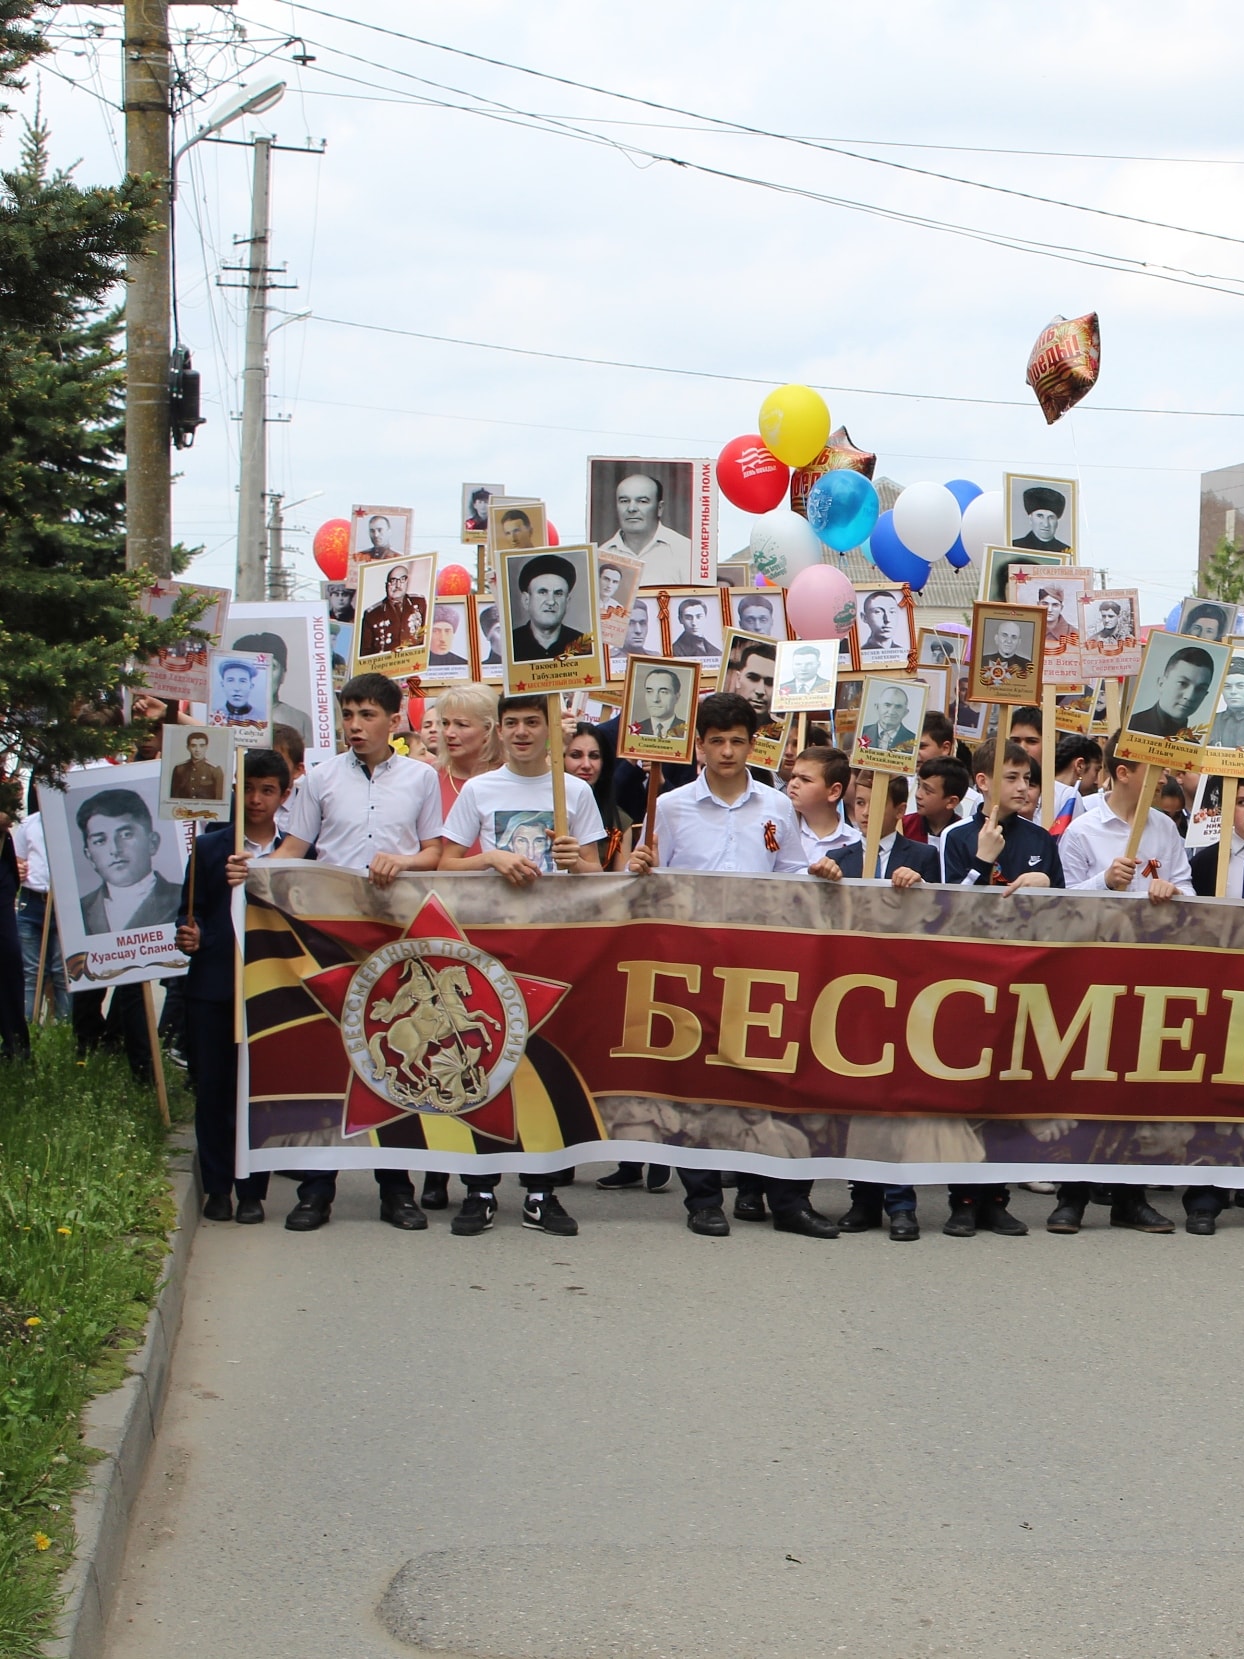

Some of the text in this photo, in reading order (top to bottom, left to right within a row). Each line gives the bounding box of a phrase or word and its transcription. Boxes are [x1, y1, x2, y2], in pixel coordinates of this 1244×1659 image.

[699, 463, 711, 579] БЕССМЕРТНЫЙ ПОЛК
[1055, 658, 1081, 667] Викт
[1043, 669, 1077, 677] гиевич
[313, 616, 331, 748] БЕССМЕРТНЫЙ ПОЛК
[1148, 747, 1174, 759] Ильич
[1164, 741, 1199, 755] Николай
[116, 930, 164, 947] МАЛИЕВ
[91, 942, 179, 963] Хуасцау Сланов
[348, 941, 526, 1064] БЕССМЕРТНЫЙ ПОЛК РОССИИ
